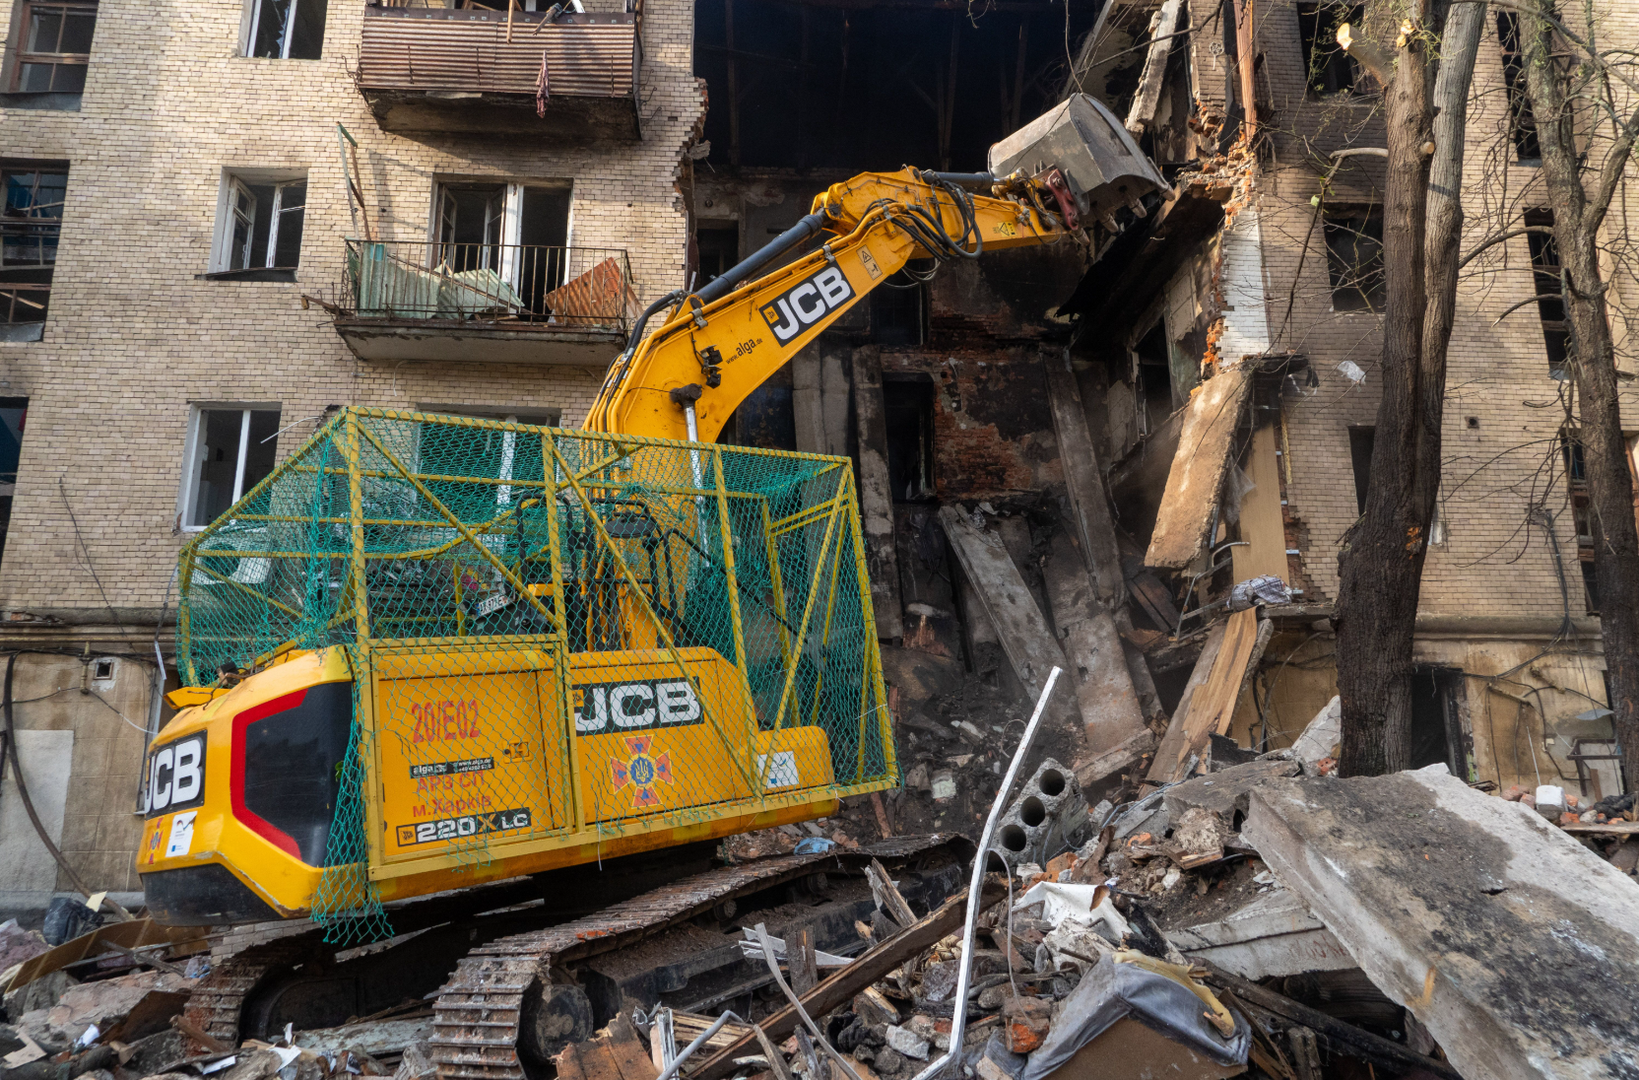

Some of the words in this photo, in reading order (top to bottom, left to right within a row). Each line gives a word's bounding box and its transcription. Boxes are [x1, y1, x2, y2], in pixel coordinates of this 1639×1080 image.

[773, 266, 851, 340] JCB
[574, 681, 701, 731] JCB
[144, 739, 202, 814] JCB
[501, 813, 528, 830] LC
